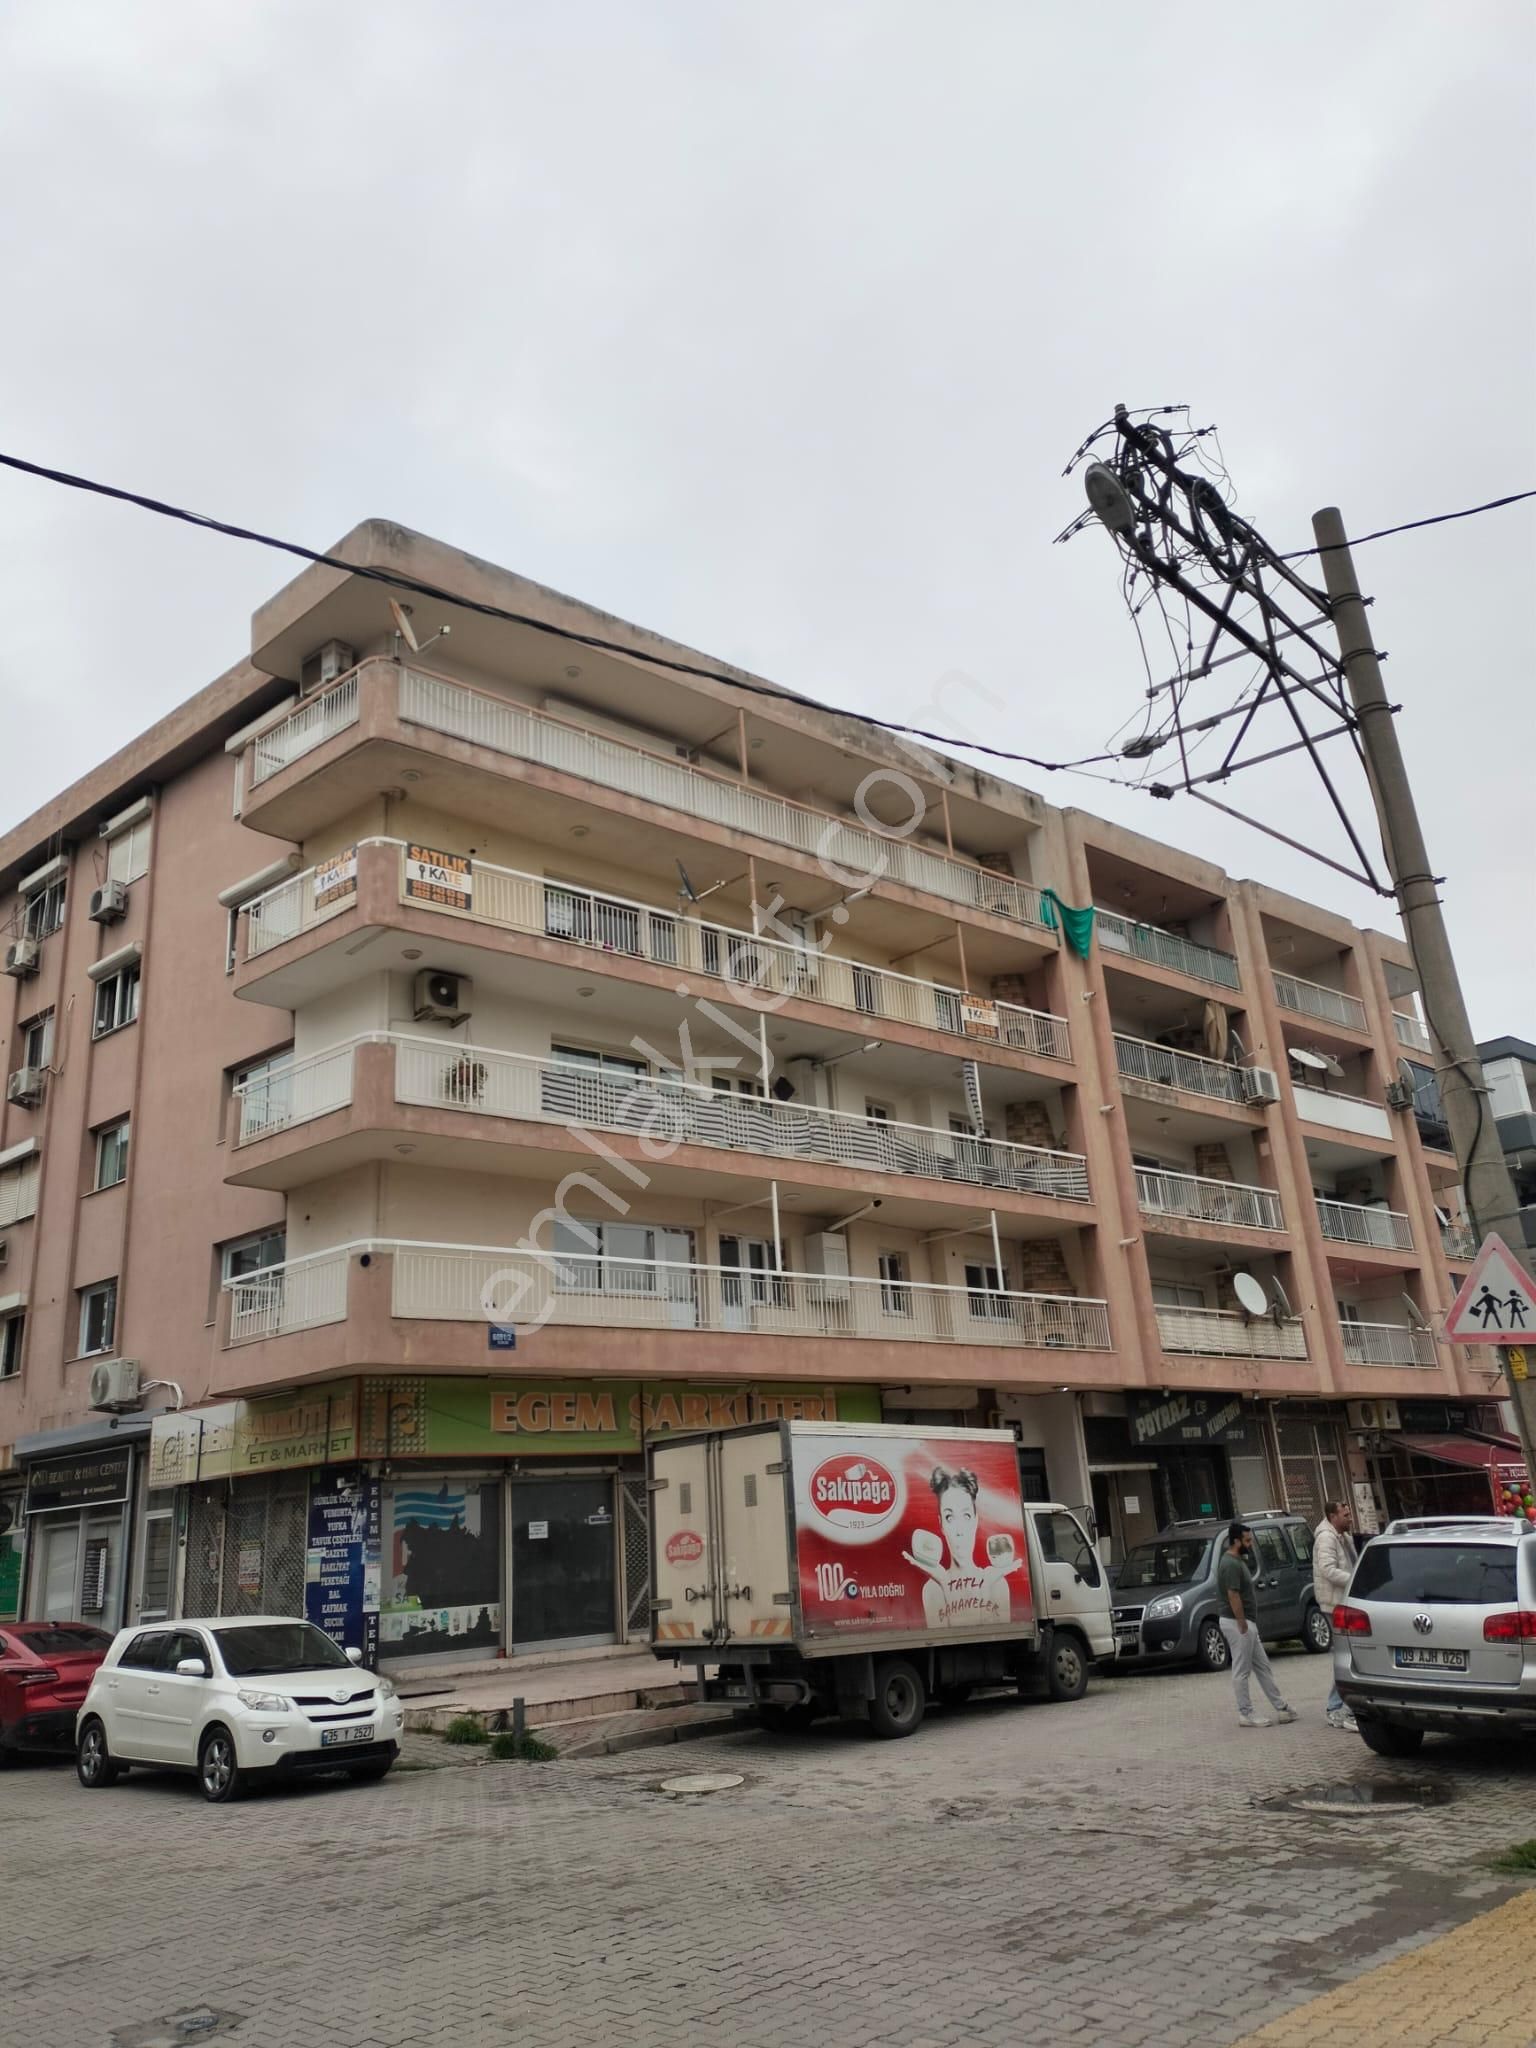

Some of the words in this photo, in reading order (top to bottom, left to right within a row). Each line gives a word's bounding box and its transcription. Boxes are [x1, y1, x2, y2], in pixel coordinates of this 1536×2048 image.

[410, 846, 468, 874] SATILIK
[429, 866, 463, 888] KATE
[490, 1391, 618, 1432] EGEM
[628, 1383, 837, 1441] ŞARKÜTERİ
[1136, 1394, 1190, 1441] POYRAZ
[249, 1449, 266, 1465] ET
[269, 1448, 281, 1461] &
[283, 1436, 351, 1460] MARKET
[327, 1521, 347, 1531] YUFKA
[312, 1536, 332, 1546] TAVUK
[325, 1548, 348, 1558] GAZETE
[860, 1586, 878, 1597] YILA
[878, 1582, 905, 1597] DOĞRU
[948, 1577, 984, 1591] TATLI
[328, 1590, 341, 1599] BAL
[321, 1603, 348, 1613] KAYMAK
[938, 1597, 1000, 1622] BAHANELER
[323, 1617, 344, 1627] SUCUK
[1401, 1650, 1414, 1662] 09
[1418, 1651, 1438, 1663] AJH
[1442, 1652, 1463, 1665] 026
[328, 1731, 338, 1741] 35
[354, 1727, 372, 1738] 2527
